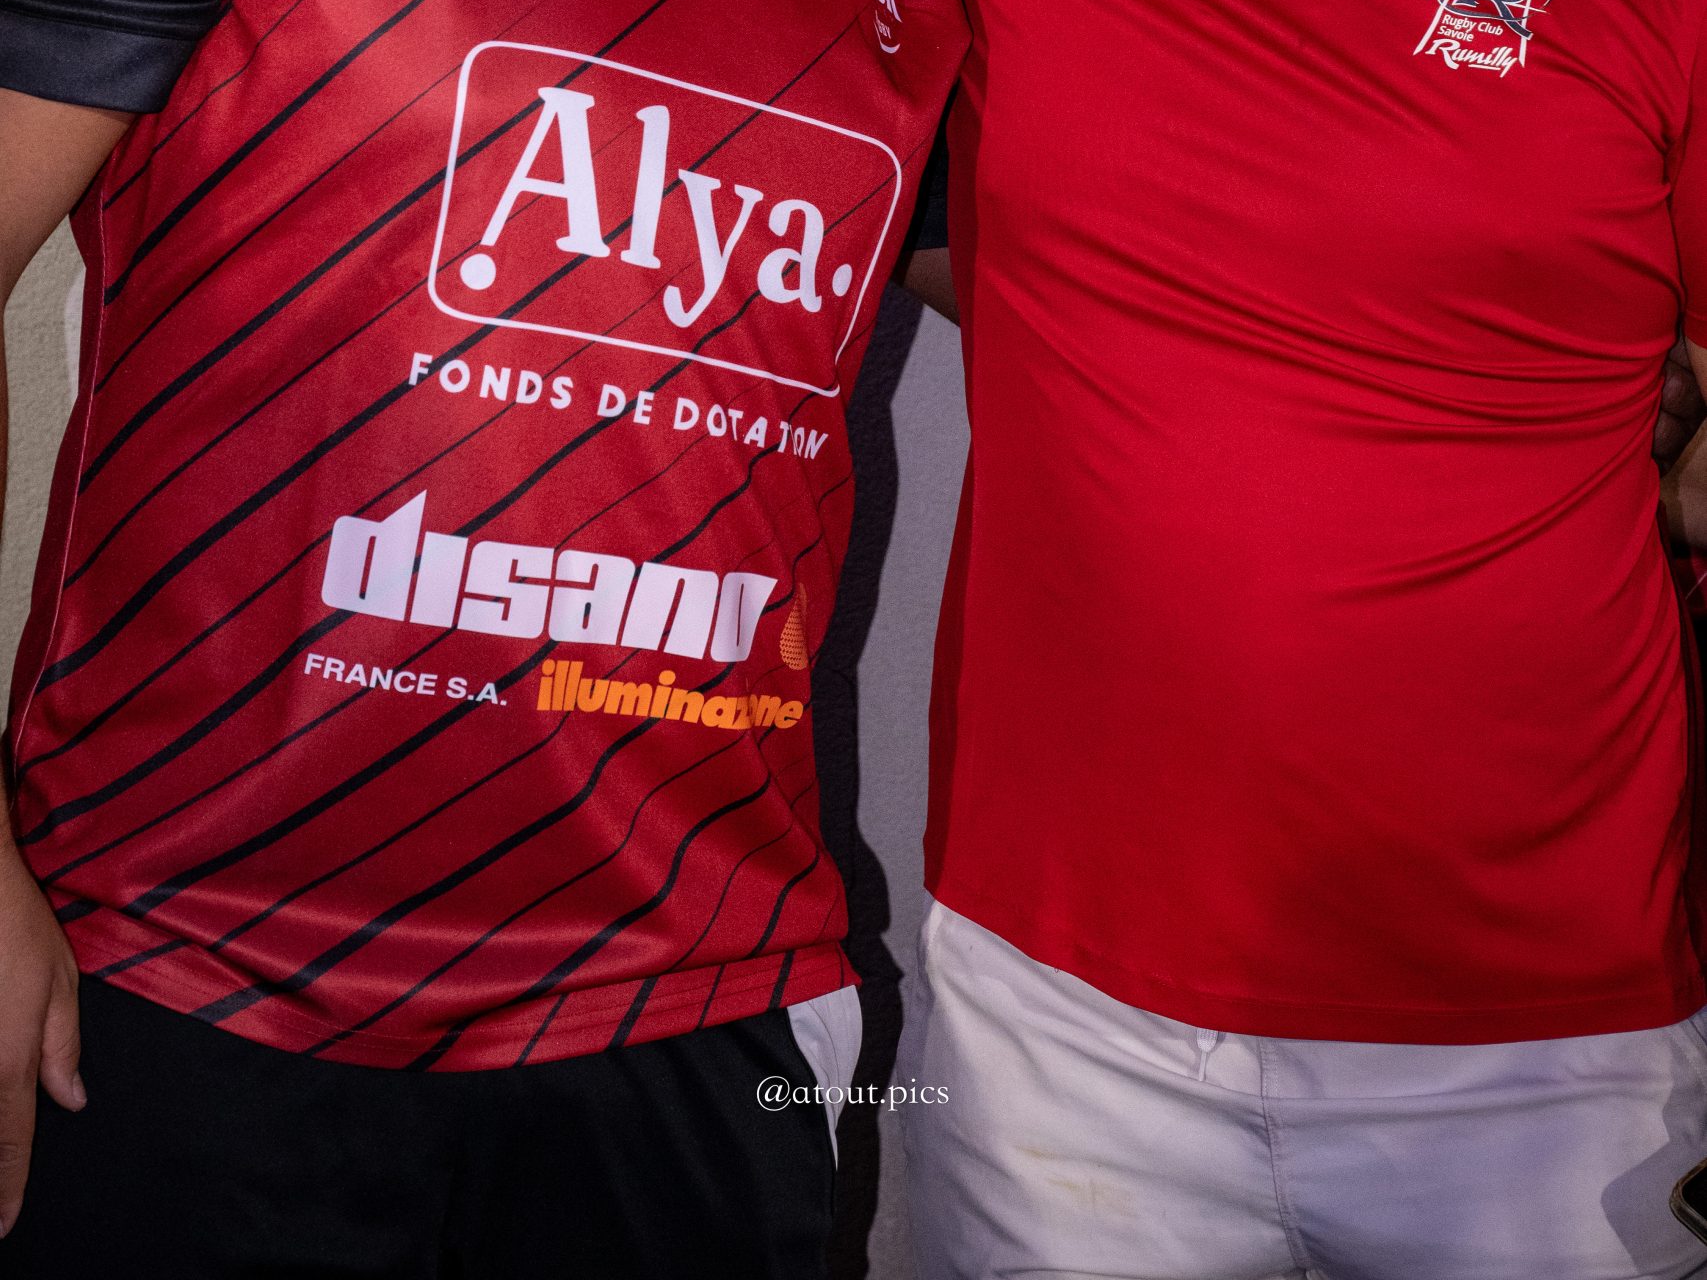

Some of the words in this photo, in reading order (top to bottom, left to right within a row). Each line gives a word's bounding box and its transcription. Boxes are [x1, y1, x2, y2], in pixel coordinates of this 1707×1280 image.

[1437, 25, 1475, 42] Savoie
[1442, 14, 1477, 33] Rugby
[1477, 22, 1504, 36] Club
[1425, 38, 1518, 78] Rumilly
[408, 352, 574, 410] FONDS
[597, 384, 655, 426] DE
[321, 489, 778, 663] disano
[303, 652, 439, 696] FRANCE
[446, 676, 508, 706] S.A.
